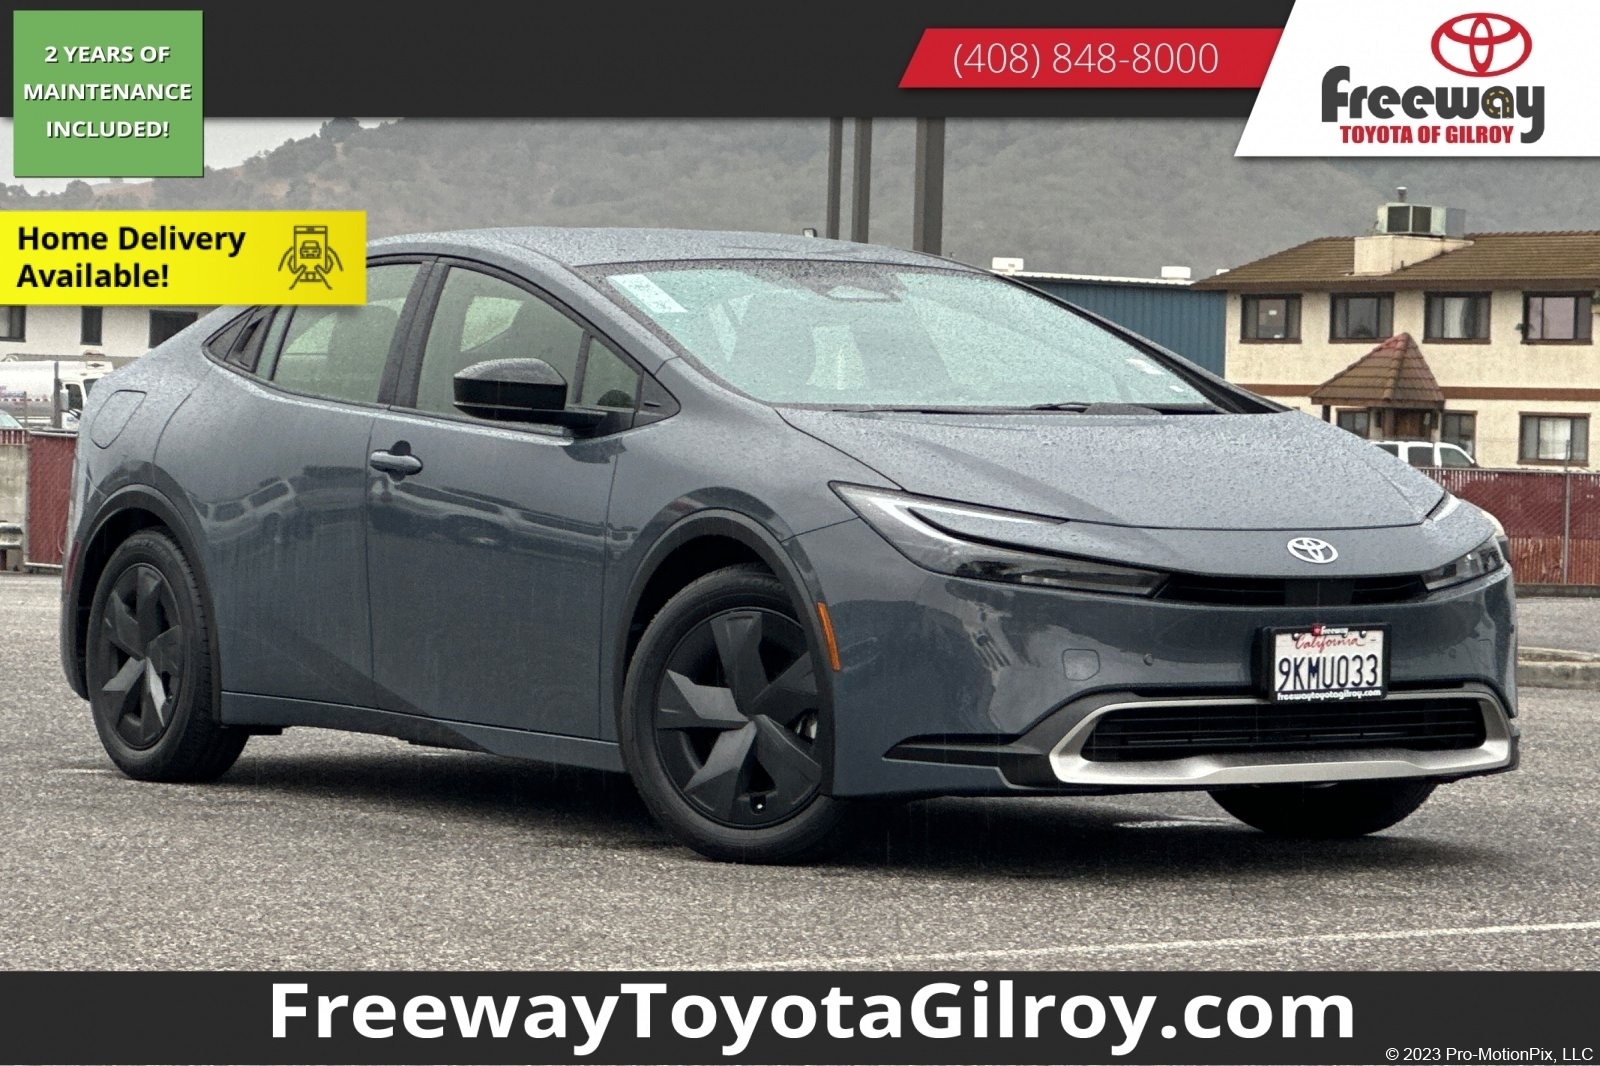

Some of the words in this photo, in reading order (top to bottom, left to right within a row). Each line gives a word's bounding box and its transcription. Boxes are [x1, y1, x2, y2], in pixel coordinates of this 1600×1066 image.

[1295, 634, 1366, 653] California
[1278, 654, 1378, 690] 9KMU033
[1277, 690, 1382, 701] freewaytoyotagilroy.com
